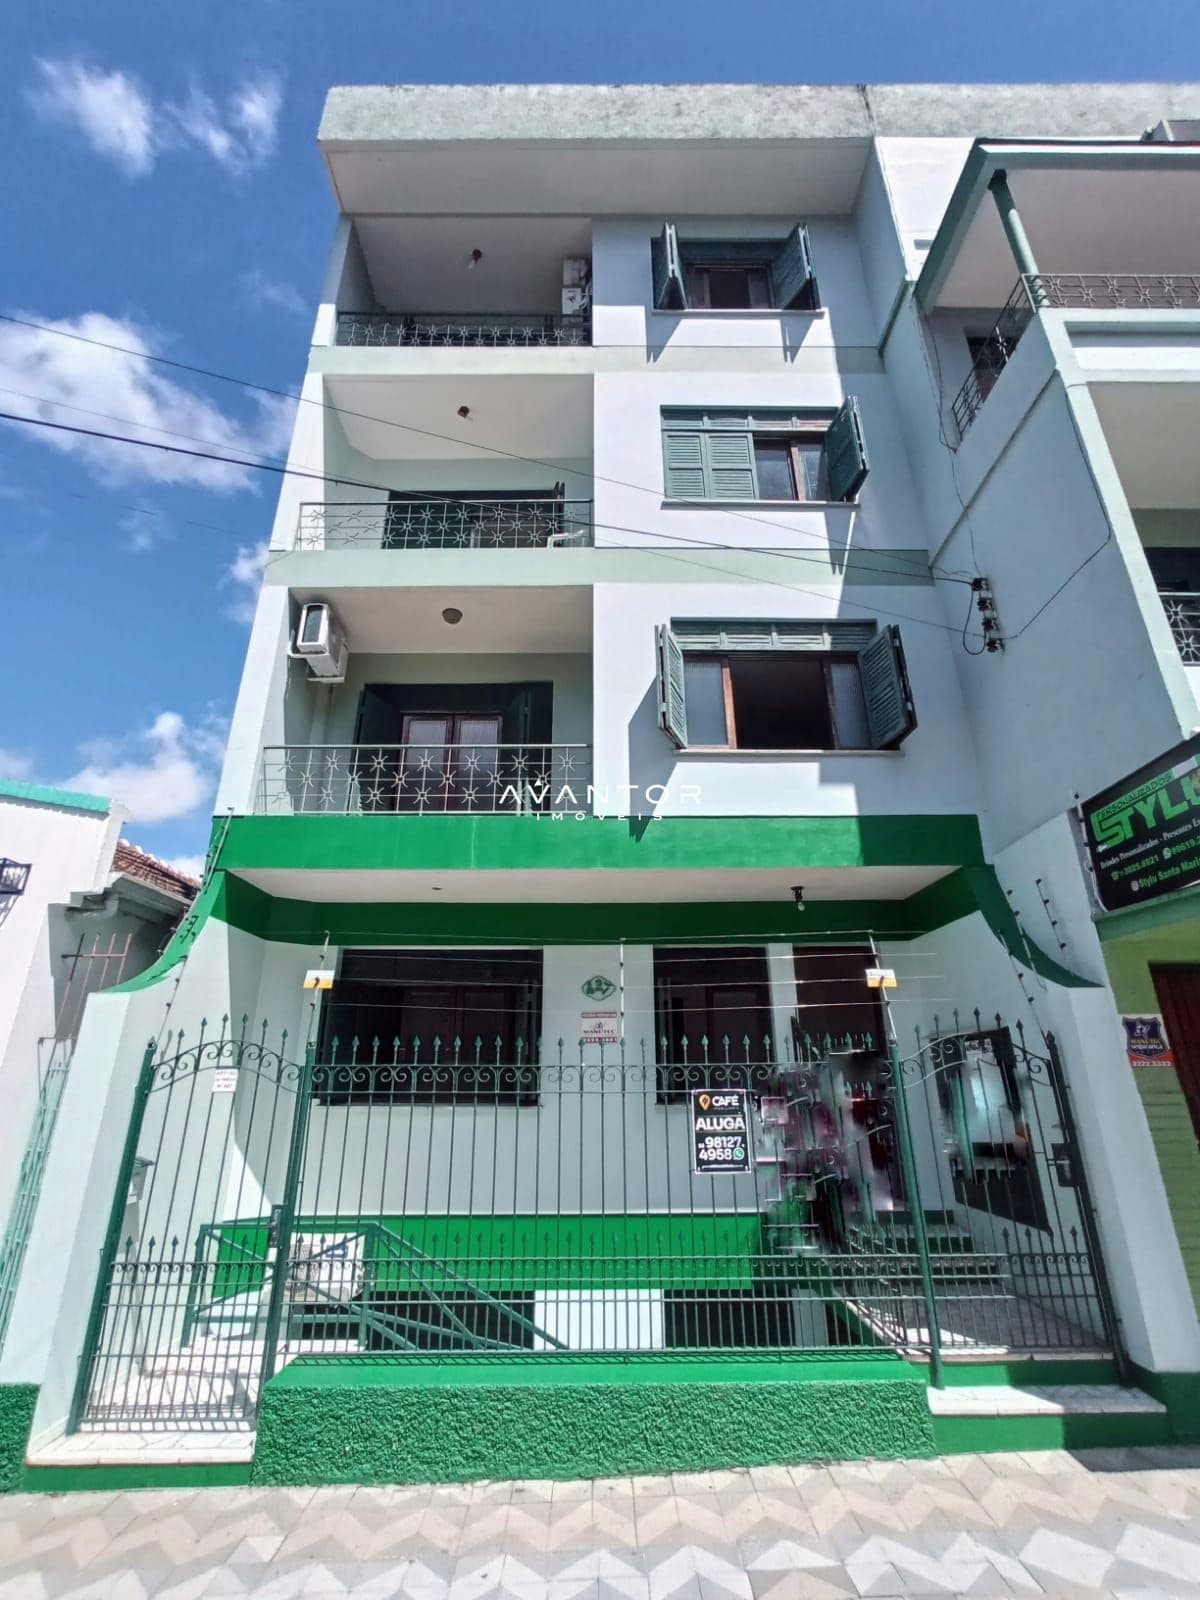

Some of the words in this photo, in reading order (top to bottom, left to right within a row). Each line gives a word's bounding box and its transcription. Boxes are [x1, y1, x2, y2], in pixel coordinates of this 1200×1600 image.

[712, 1095, 739, 1106] CAFÉ
[696, 1118, 745, 1130] ALUGA
[699, 1149, 732, 1160] 4958
